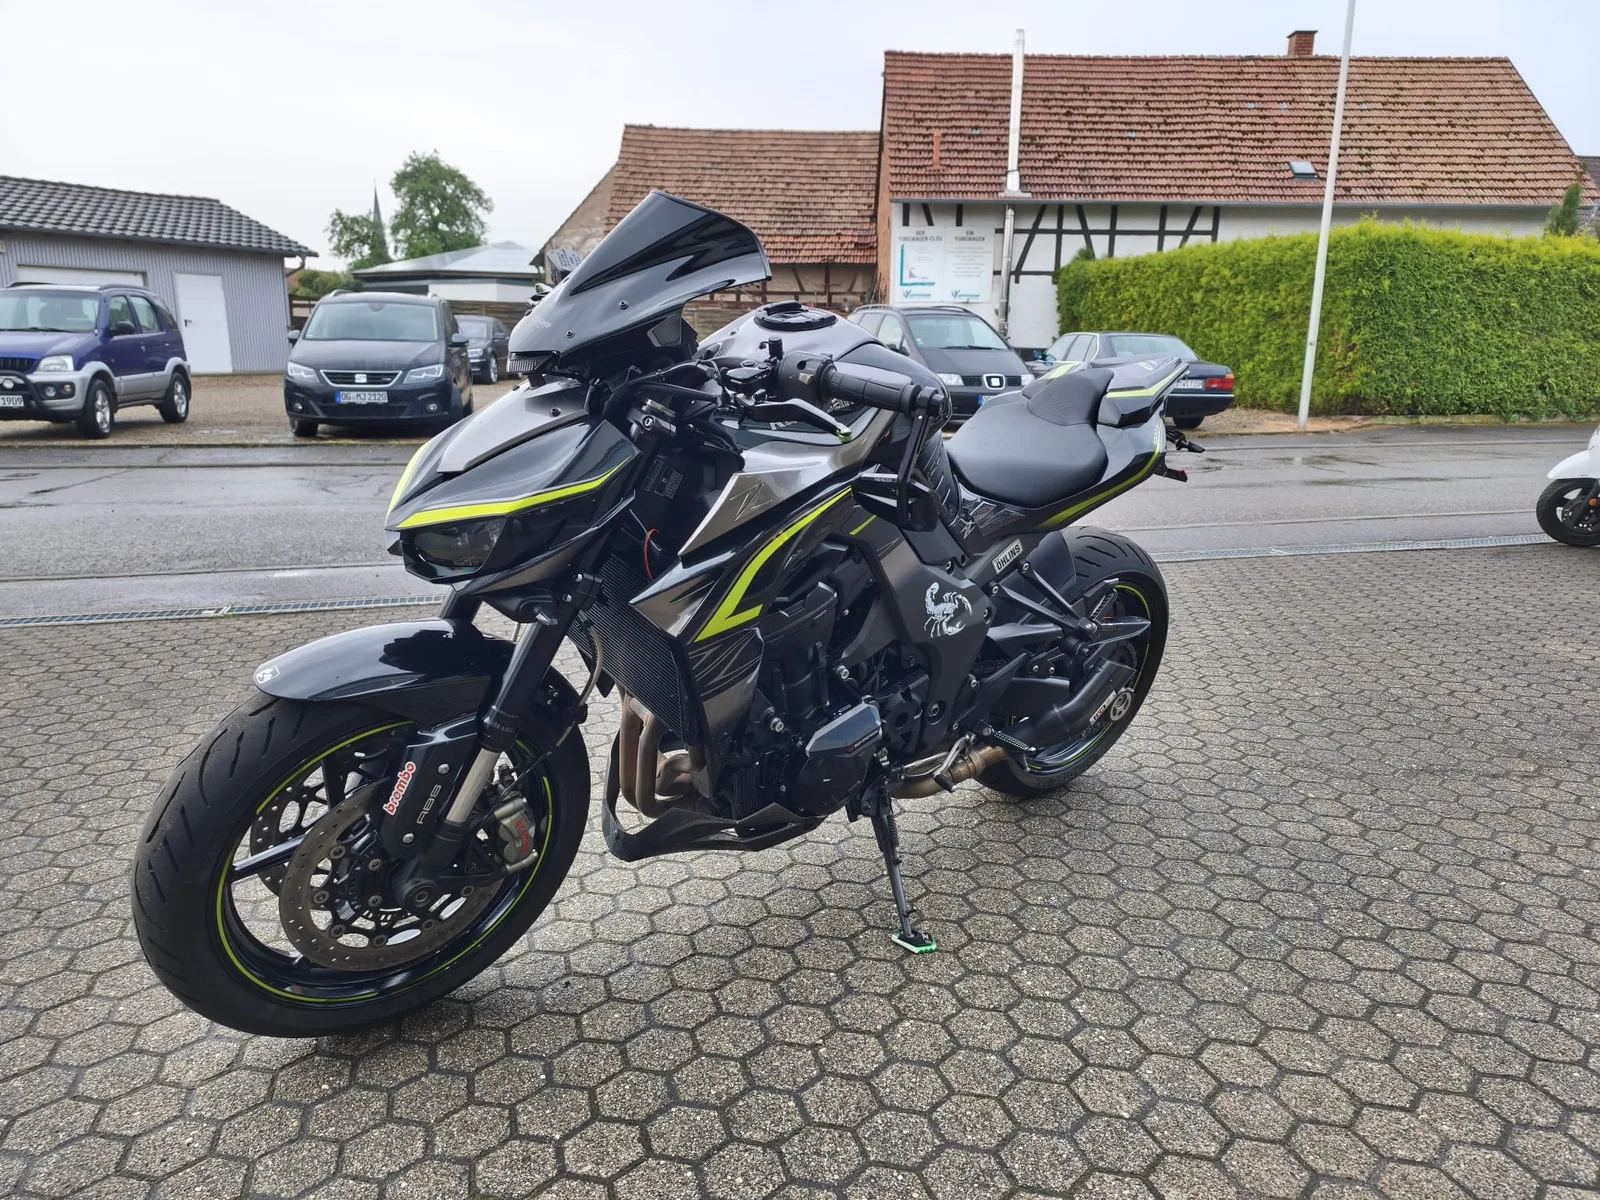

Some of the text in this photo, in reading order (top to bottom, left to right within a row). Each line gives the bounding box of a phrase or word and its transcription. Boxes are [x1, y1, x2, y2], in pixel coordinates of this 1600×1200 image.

[995, 543, 1021, 571] ÖHLINS
[382, 761, 417, 816] brembo
[416, 783, 442, 825] ABS
